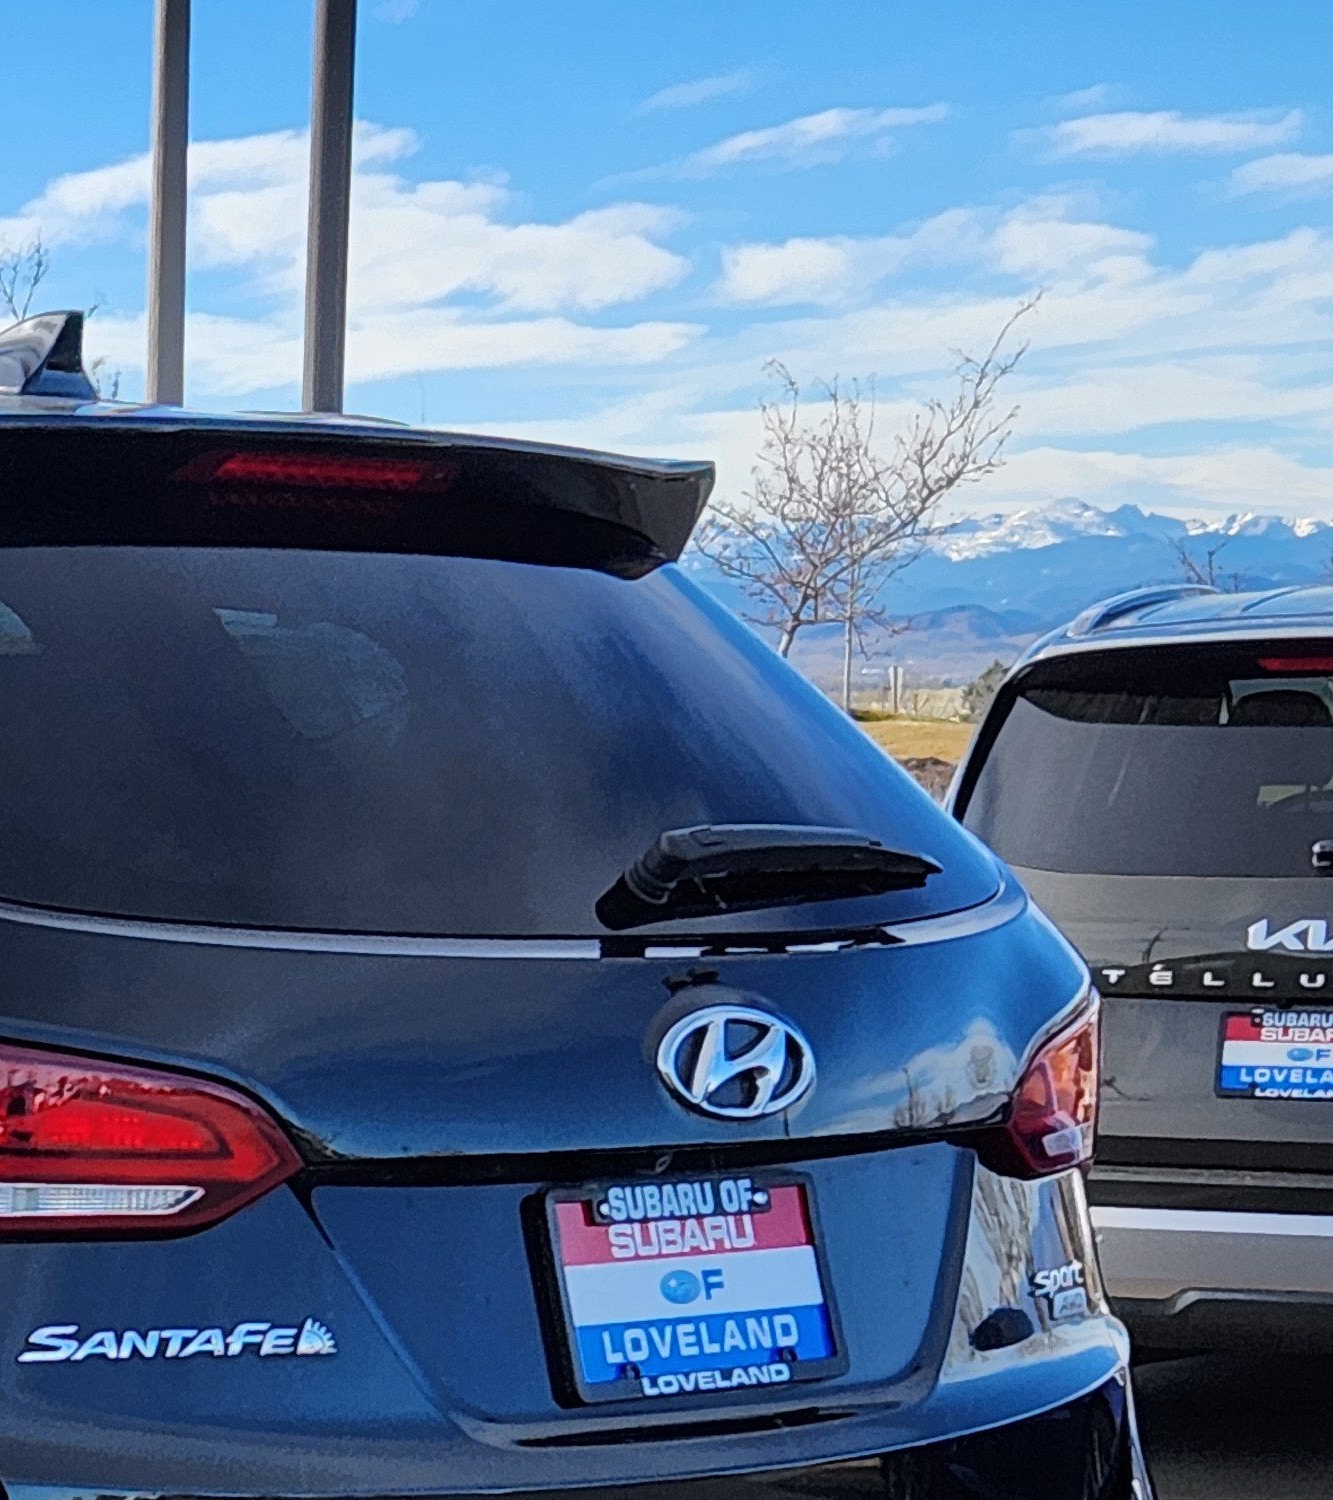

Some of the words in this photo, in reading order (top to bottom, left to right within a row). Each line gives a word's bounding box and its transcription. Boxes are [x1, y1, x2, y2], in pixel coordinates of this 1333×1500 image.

[1247, 918, 1333, 950] KI
[607, 1182, 713, 1222] SUBARU
[720, 1177, 753, 1214] OF
[608, 1214, 757, 1258] SUBARU
[660, 1269, 726, 1305] OF
[602, 1313, 800, 1364] LOVELAND
[641, 1362, 792, 1396] LOVELAND
